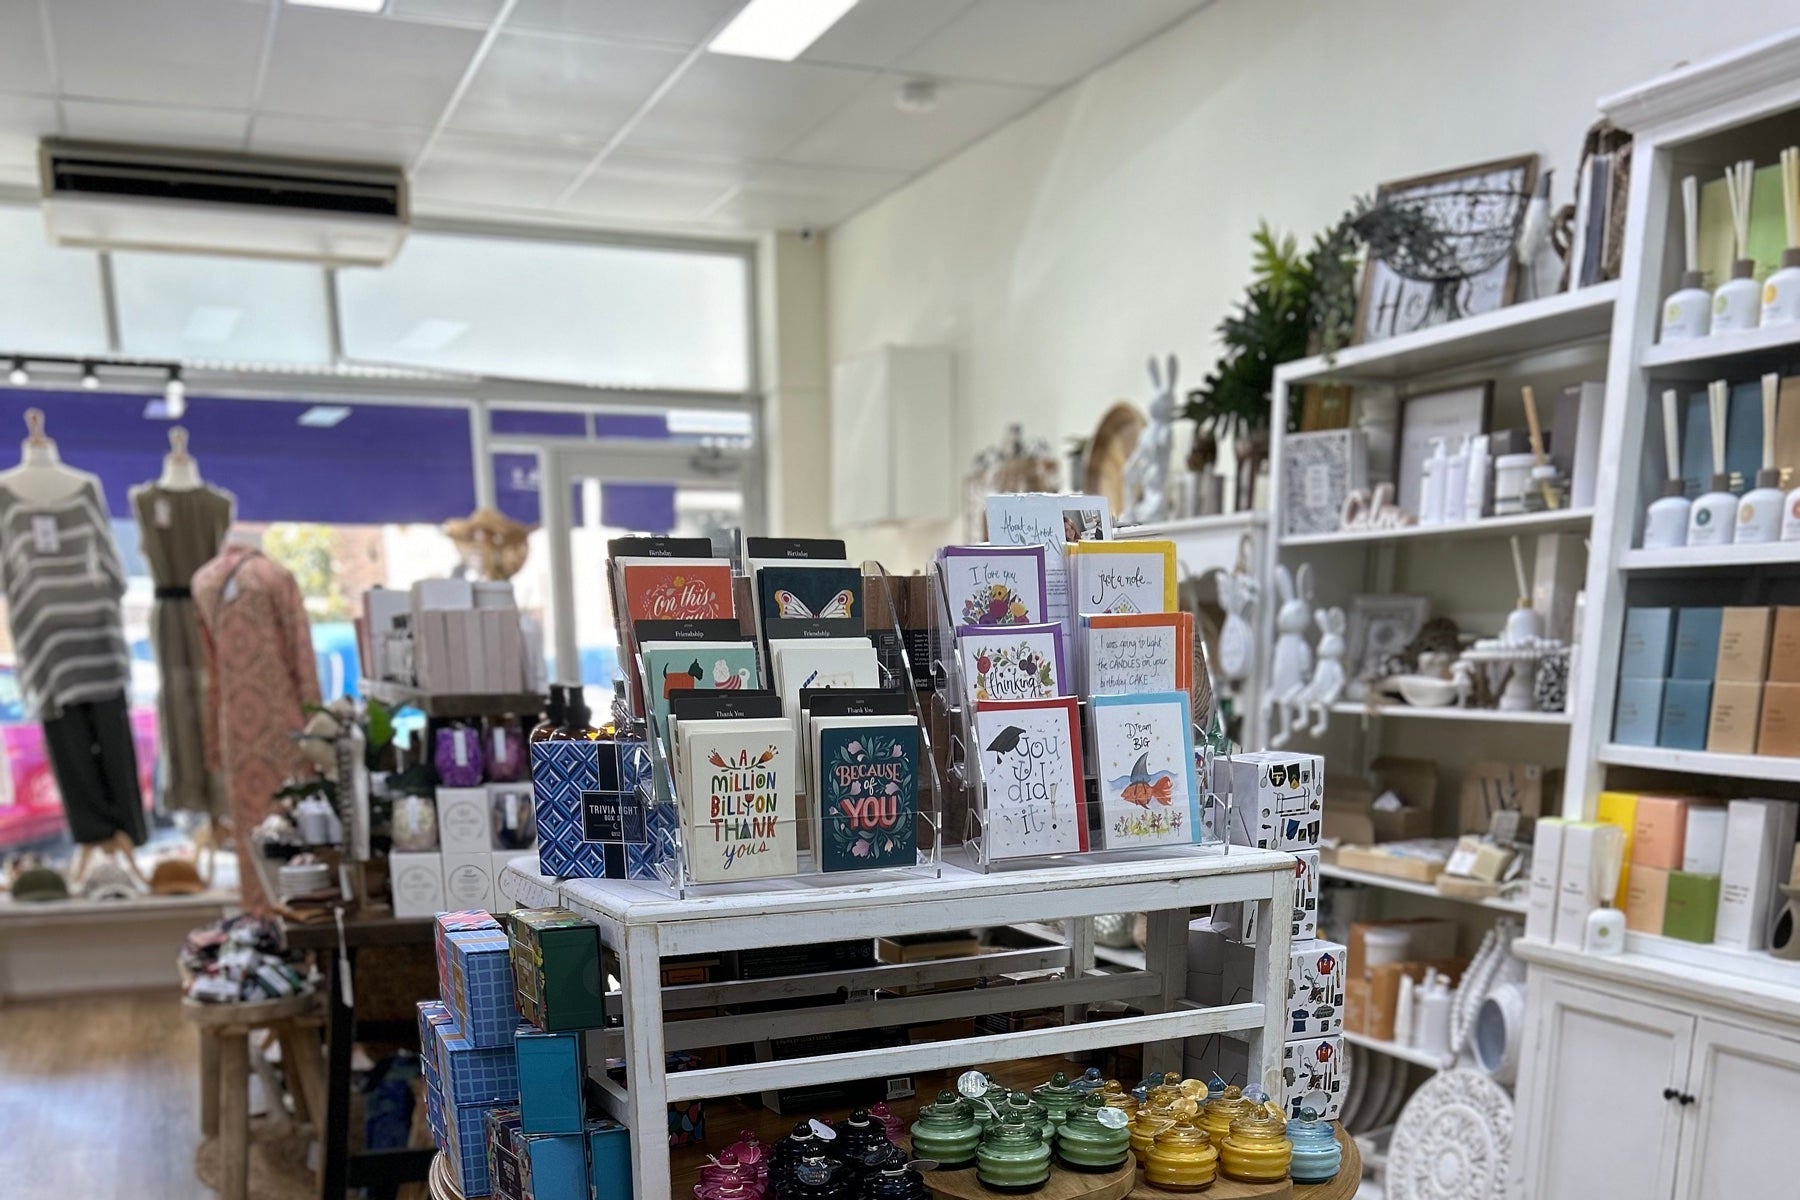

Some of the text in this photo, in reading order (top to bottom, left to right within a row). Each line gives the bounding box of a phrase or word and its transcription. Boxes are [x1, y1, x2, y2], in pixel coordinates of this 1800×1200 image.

[648, 549, 672, 557] Birthday
[983, 562, 1000, 584] love
[1003, 569, 1018, 587] you
[680, 584, 710, 607] this
[675, 630, 705, 639] Friendship
[803, 629, 831, 638] Friendship
[1106, 640, 1118, 649] was
[1115, 639, 1137, 659] going
[1145, 636, 1162, 659] light
[1097, 659, 1108, 671] the
[1109, 658, 1140, 669] CANDLES
[1151, 659, 1168, 678] your
[988, 666, 1043, 698] thinking
[1129, 674, 1148, 686] CAKE
[1124, 722, 1152, 739] Dream
[739, 749, 748, 766] A
[835, 762, 903, 787] BECAUSE
[1007, 761, 1049, 803] did
[863, 777, 878, 796] of
[589, 804, 616, 815] TRIVIA
[840, 795, 898, 830] YOU
[709, 815, 779, 842] THANK
